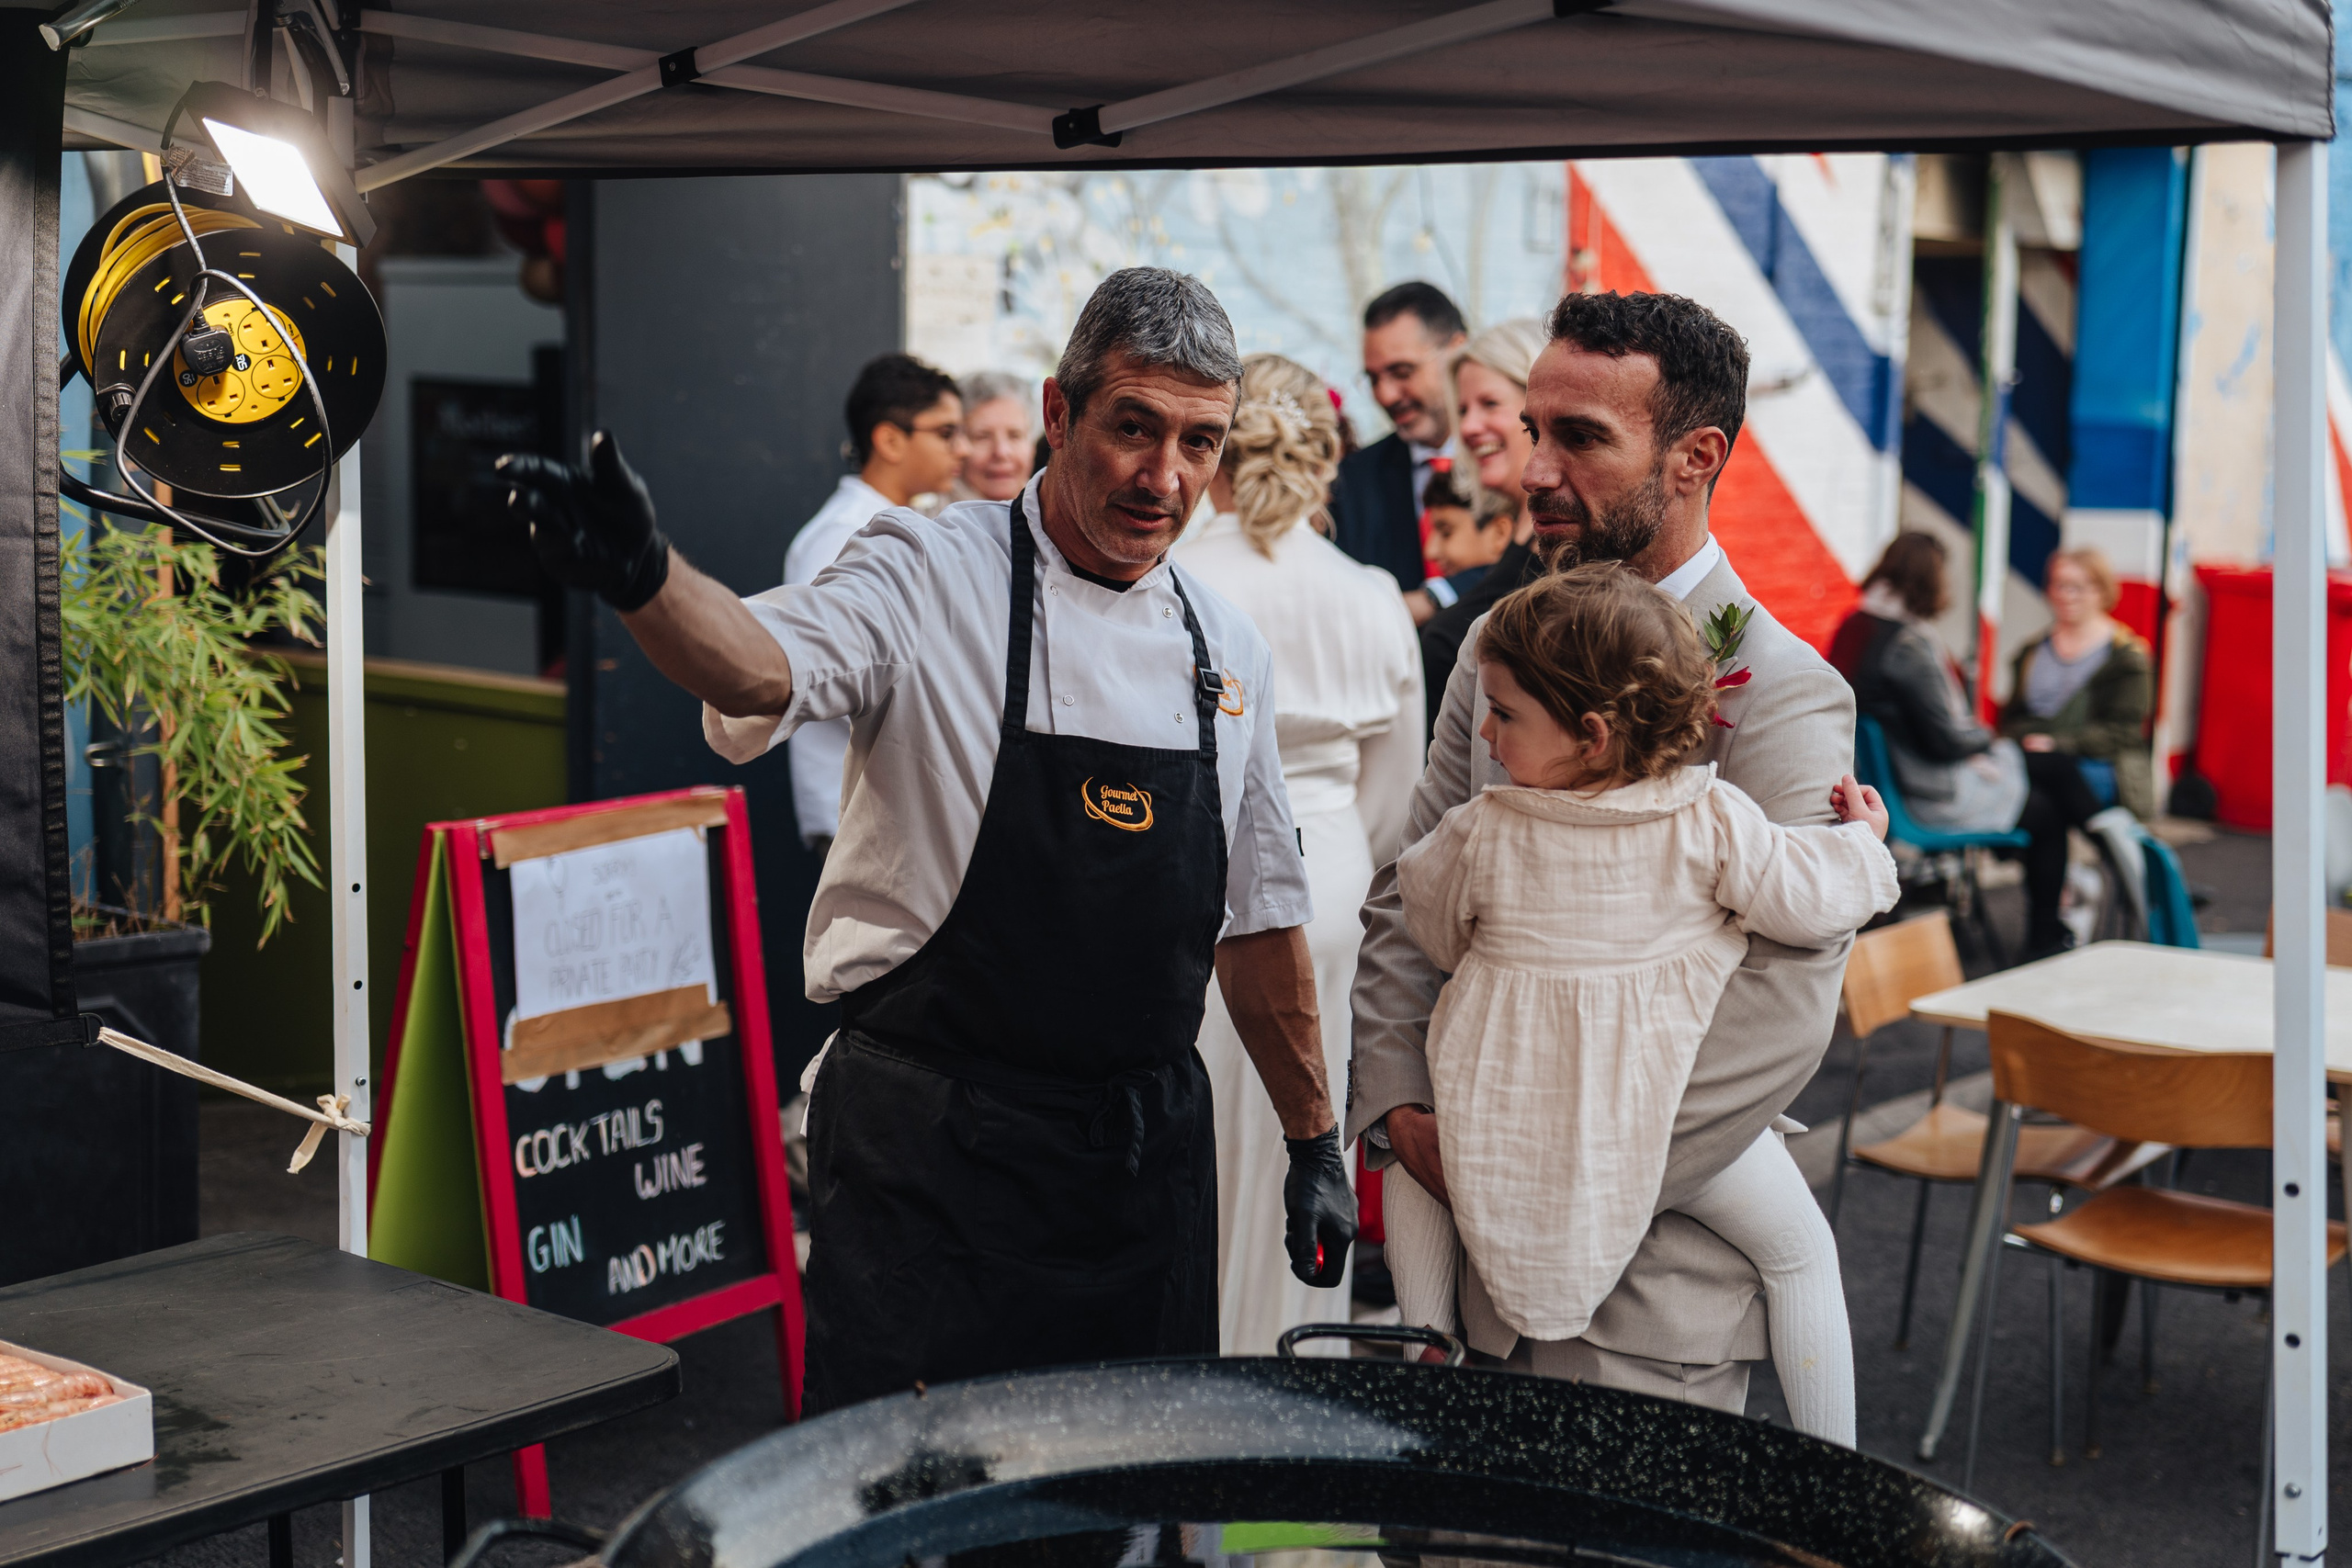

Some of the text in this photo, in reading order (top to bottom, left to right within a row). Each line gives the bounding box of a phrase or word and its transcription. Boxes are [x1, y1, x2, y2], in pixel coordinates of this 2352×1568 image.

[183, 373, 192, 385] 50
[1100, 784, 1138, 802] Gourmet
[1102, 799, 1133, 816] Paella
[655, 894, 675, 936] A
[515, 1099, 663, 1179] COCKTAILS
[634, 1142, 707, 1200] WINE
[527, 1213, 585, 1273] GIN
[607, 1219, 726, 1296] AND MORE
